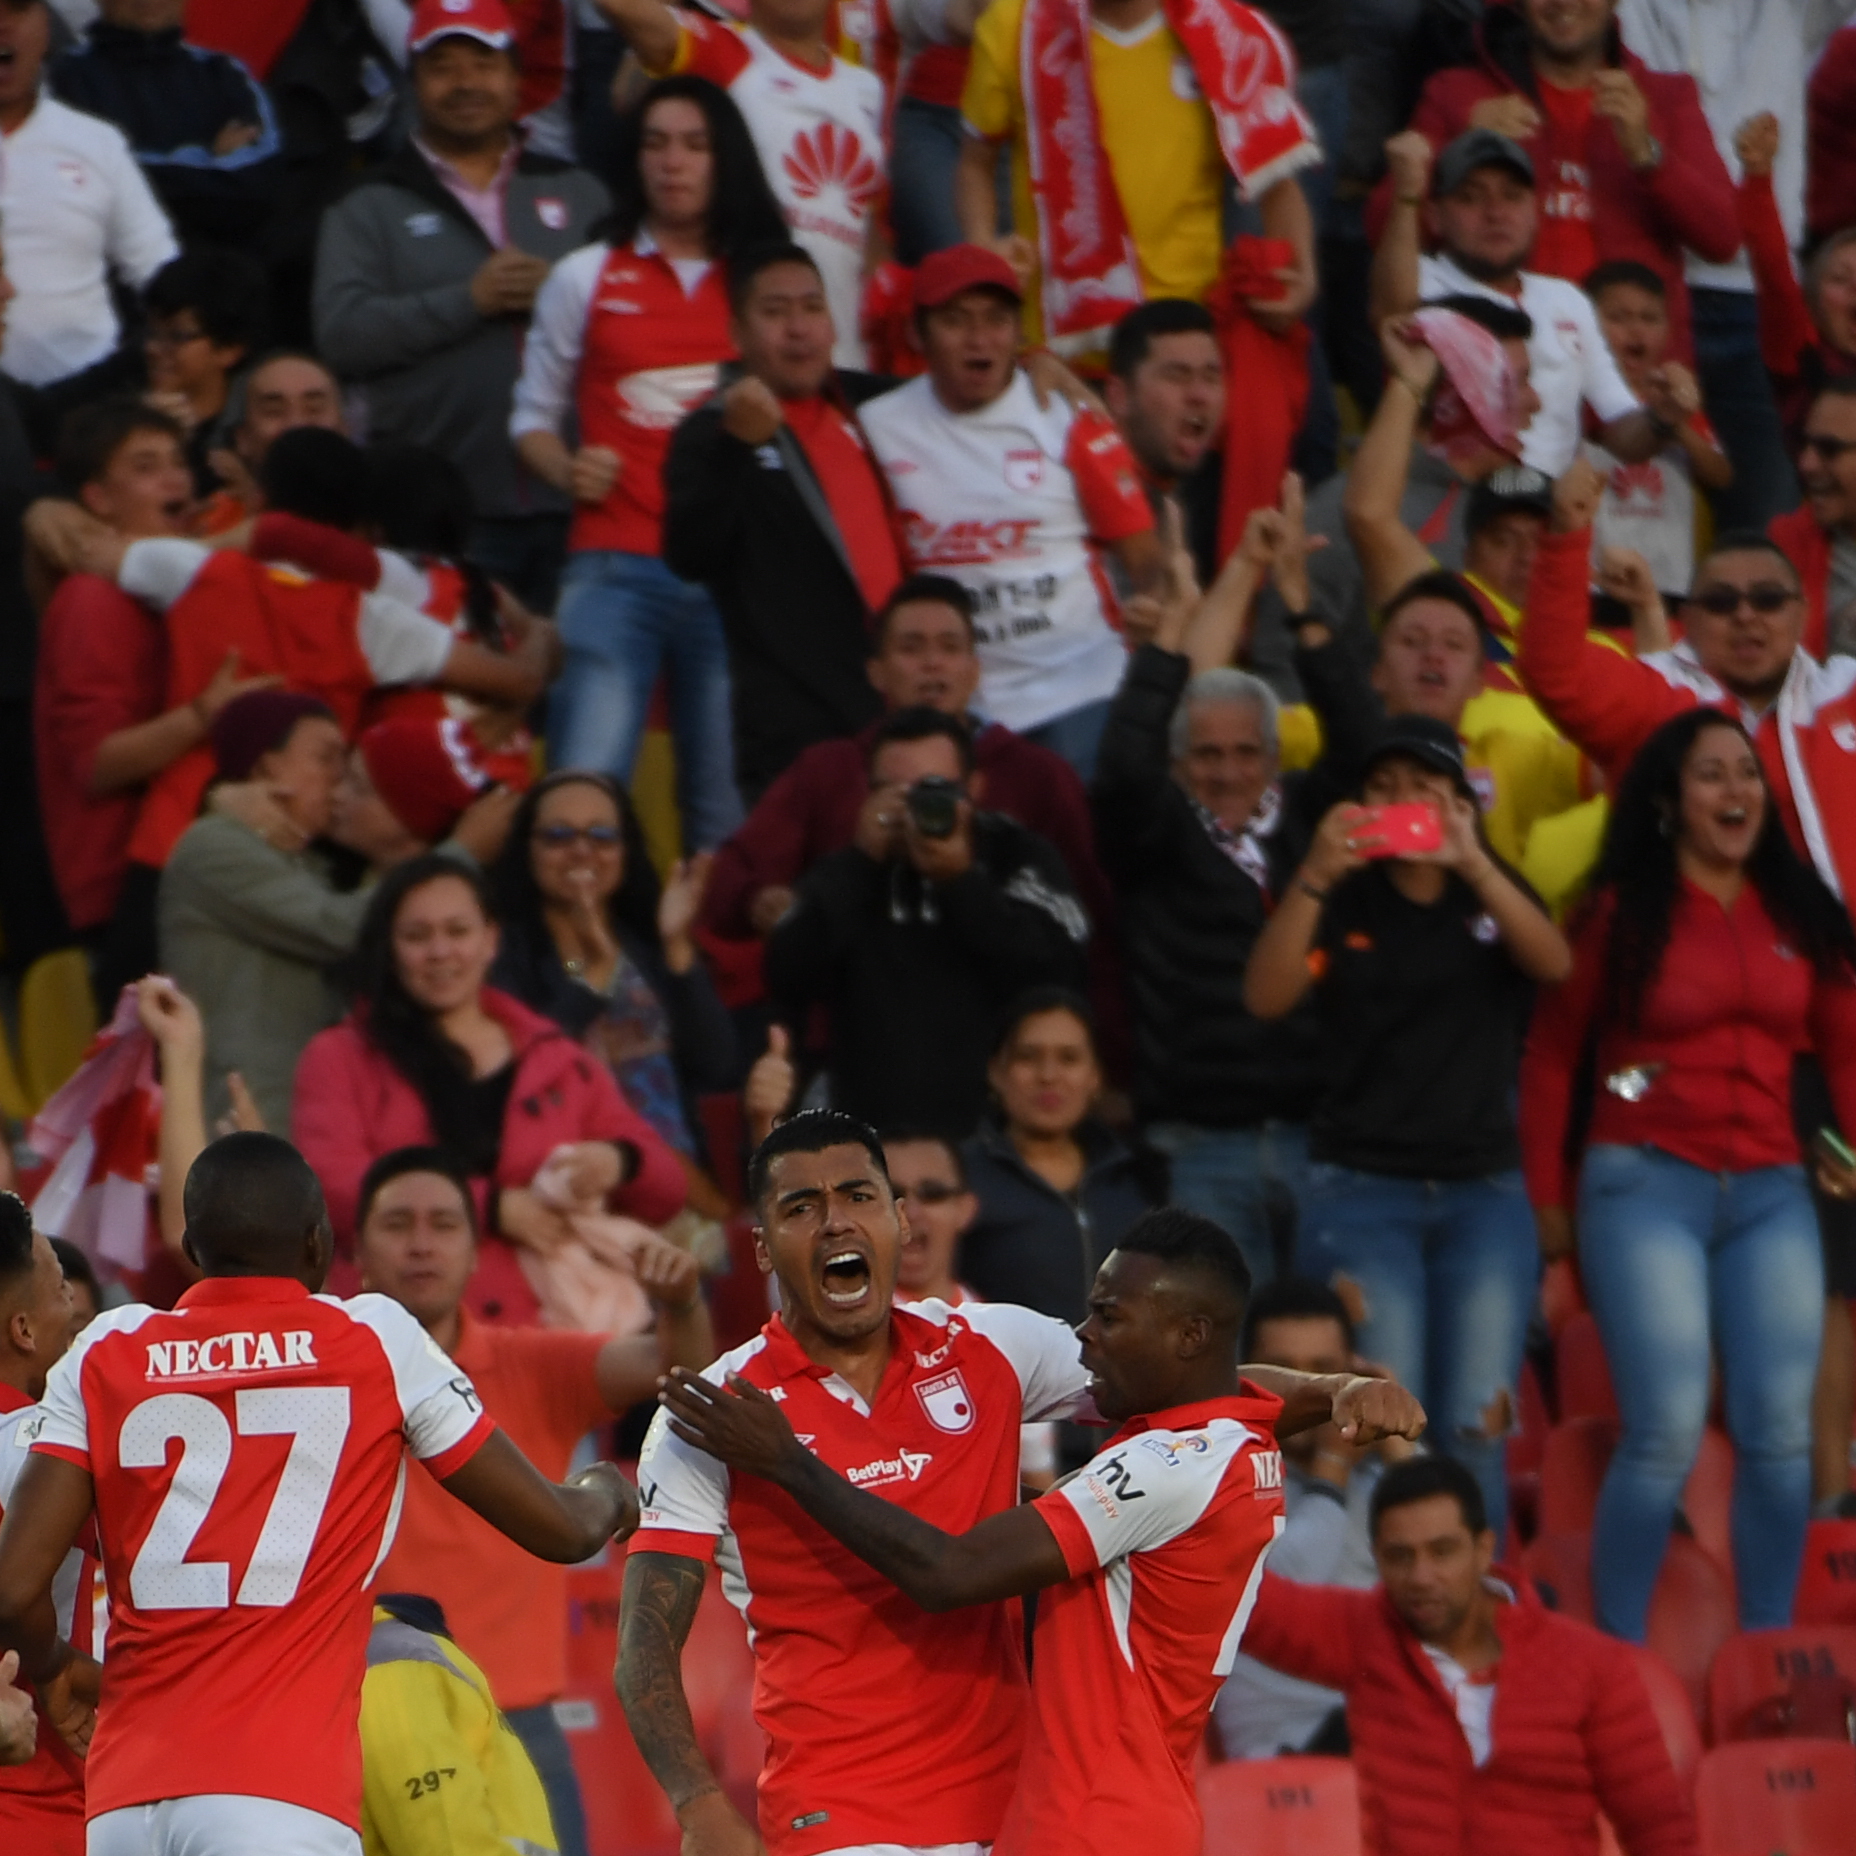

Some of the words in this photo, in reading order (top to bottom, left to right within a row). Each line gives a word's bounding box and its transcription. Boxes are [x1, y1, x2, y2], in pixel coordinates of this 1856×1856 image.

[145, 1330, 318, 1377] NECTAR
[919, 1379, 948, 1397] SANTA
[846, 1459, 902, 1483] BetPlay
[1096, 1451, 1146, 1501] hv
[118, 1386, 351, 1610] 27
